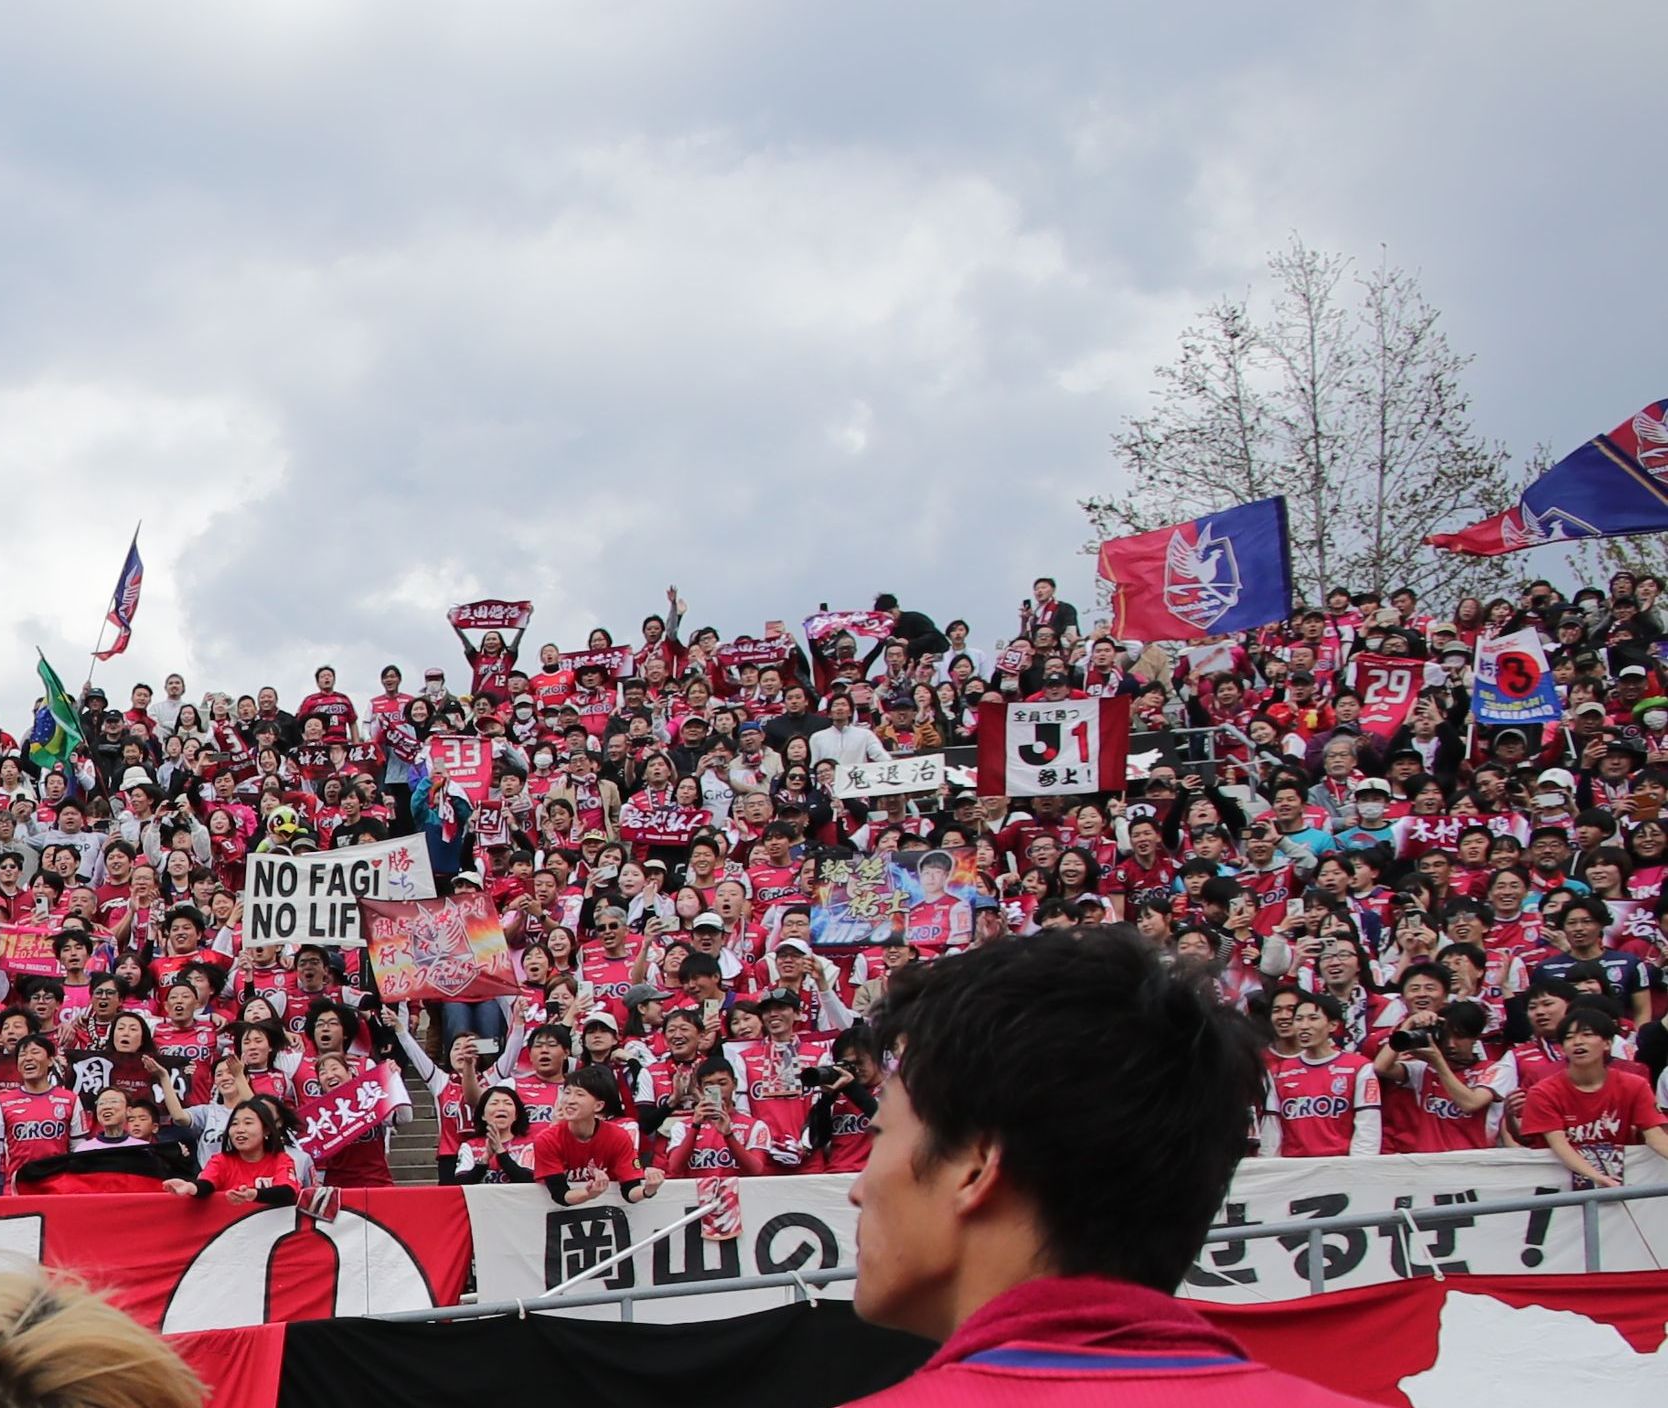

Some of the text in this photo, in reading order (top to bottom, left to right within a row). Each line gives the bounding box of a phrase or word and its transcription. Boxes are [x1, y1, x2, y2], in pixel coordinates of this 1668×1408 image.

[1365, 670, 1410, 704] 29
[1504, 656, 1531, 694] 3
[1014, 708, 1080, 723] 全員で勝つ
[442, 739, 482, 768] 33
[843, 759, 937, 790] 鬼退治
[480, 809, 498, 825] 24
[253, 860, 299, 897] NO
[250, 898, 364, 939] NO LIF
[1281, 1096, 1350, 1119] GROP
[14, 1122, 65, 1141] GROP
